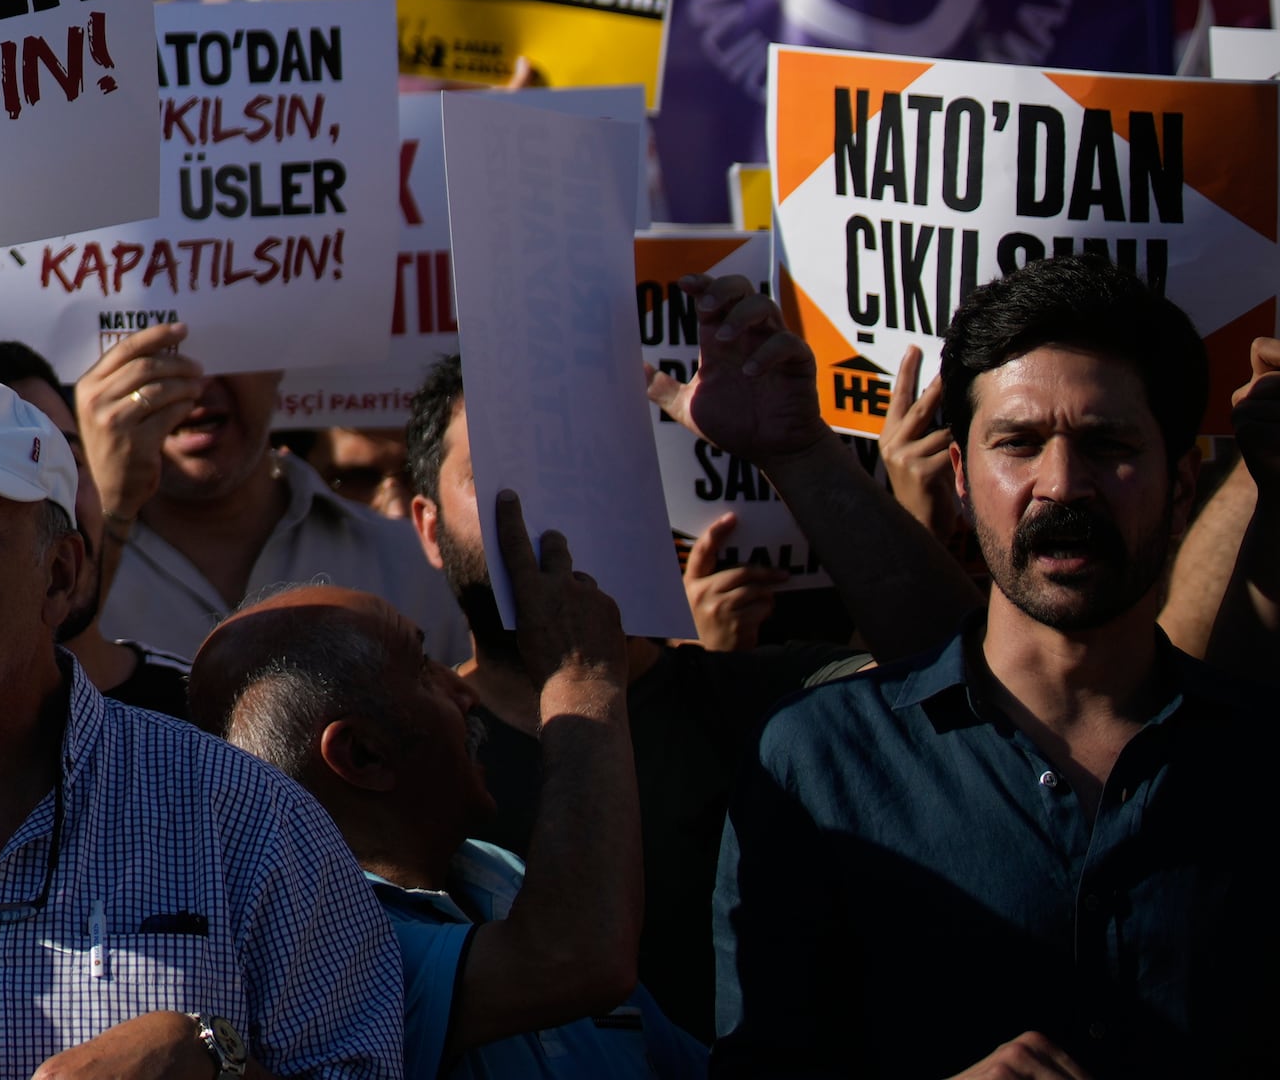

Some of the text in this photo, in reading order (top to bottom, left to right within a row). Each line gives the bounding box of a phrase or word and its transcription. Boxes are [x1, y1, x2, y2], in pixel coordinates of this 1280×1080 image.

[179, 152, 348, 221] ÜSLER
[833, 85, 1185, 225] NATO'DAN
[40, 228, 346, 298] KAPATILSIN!
